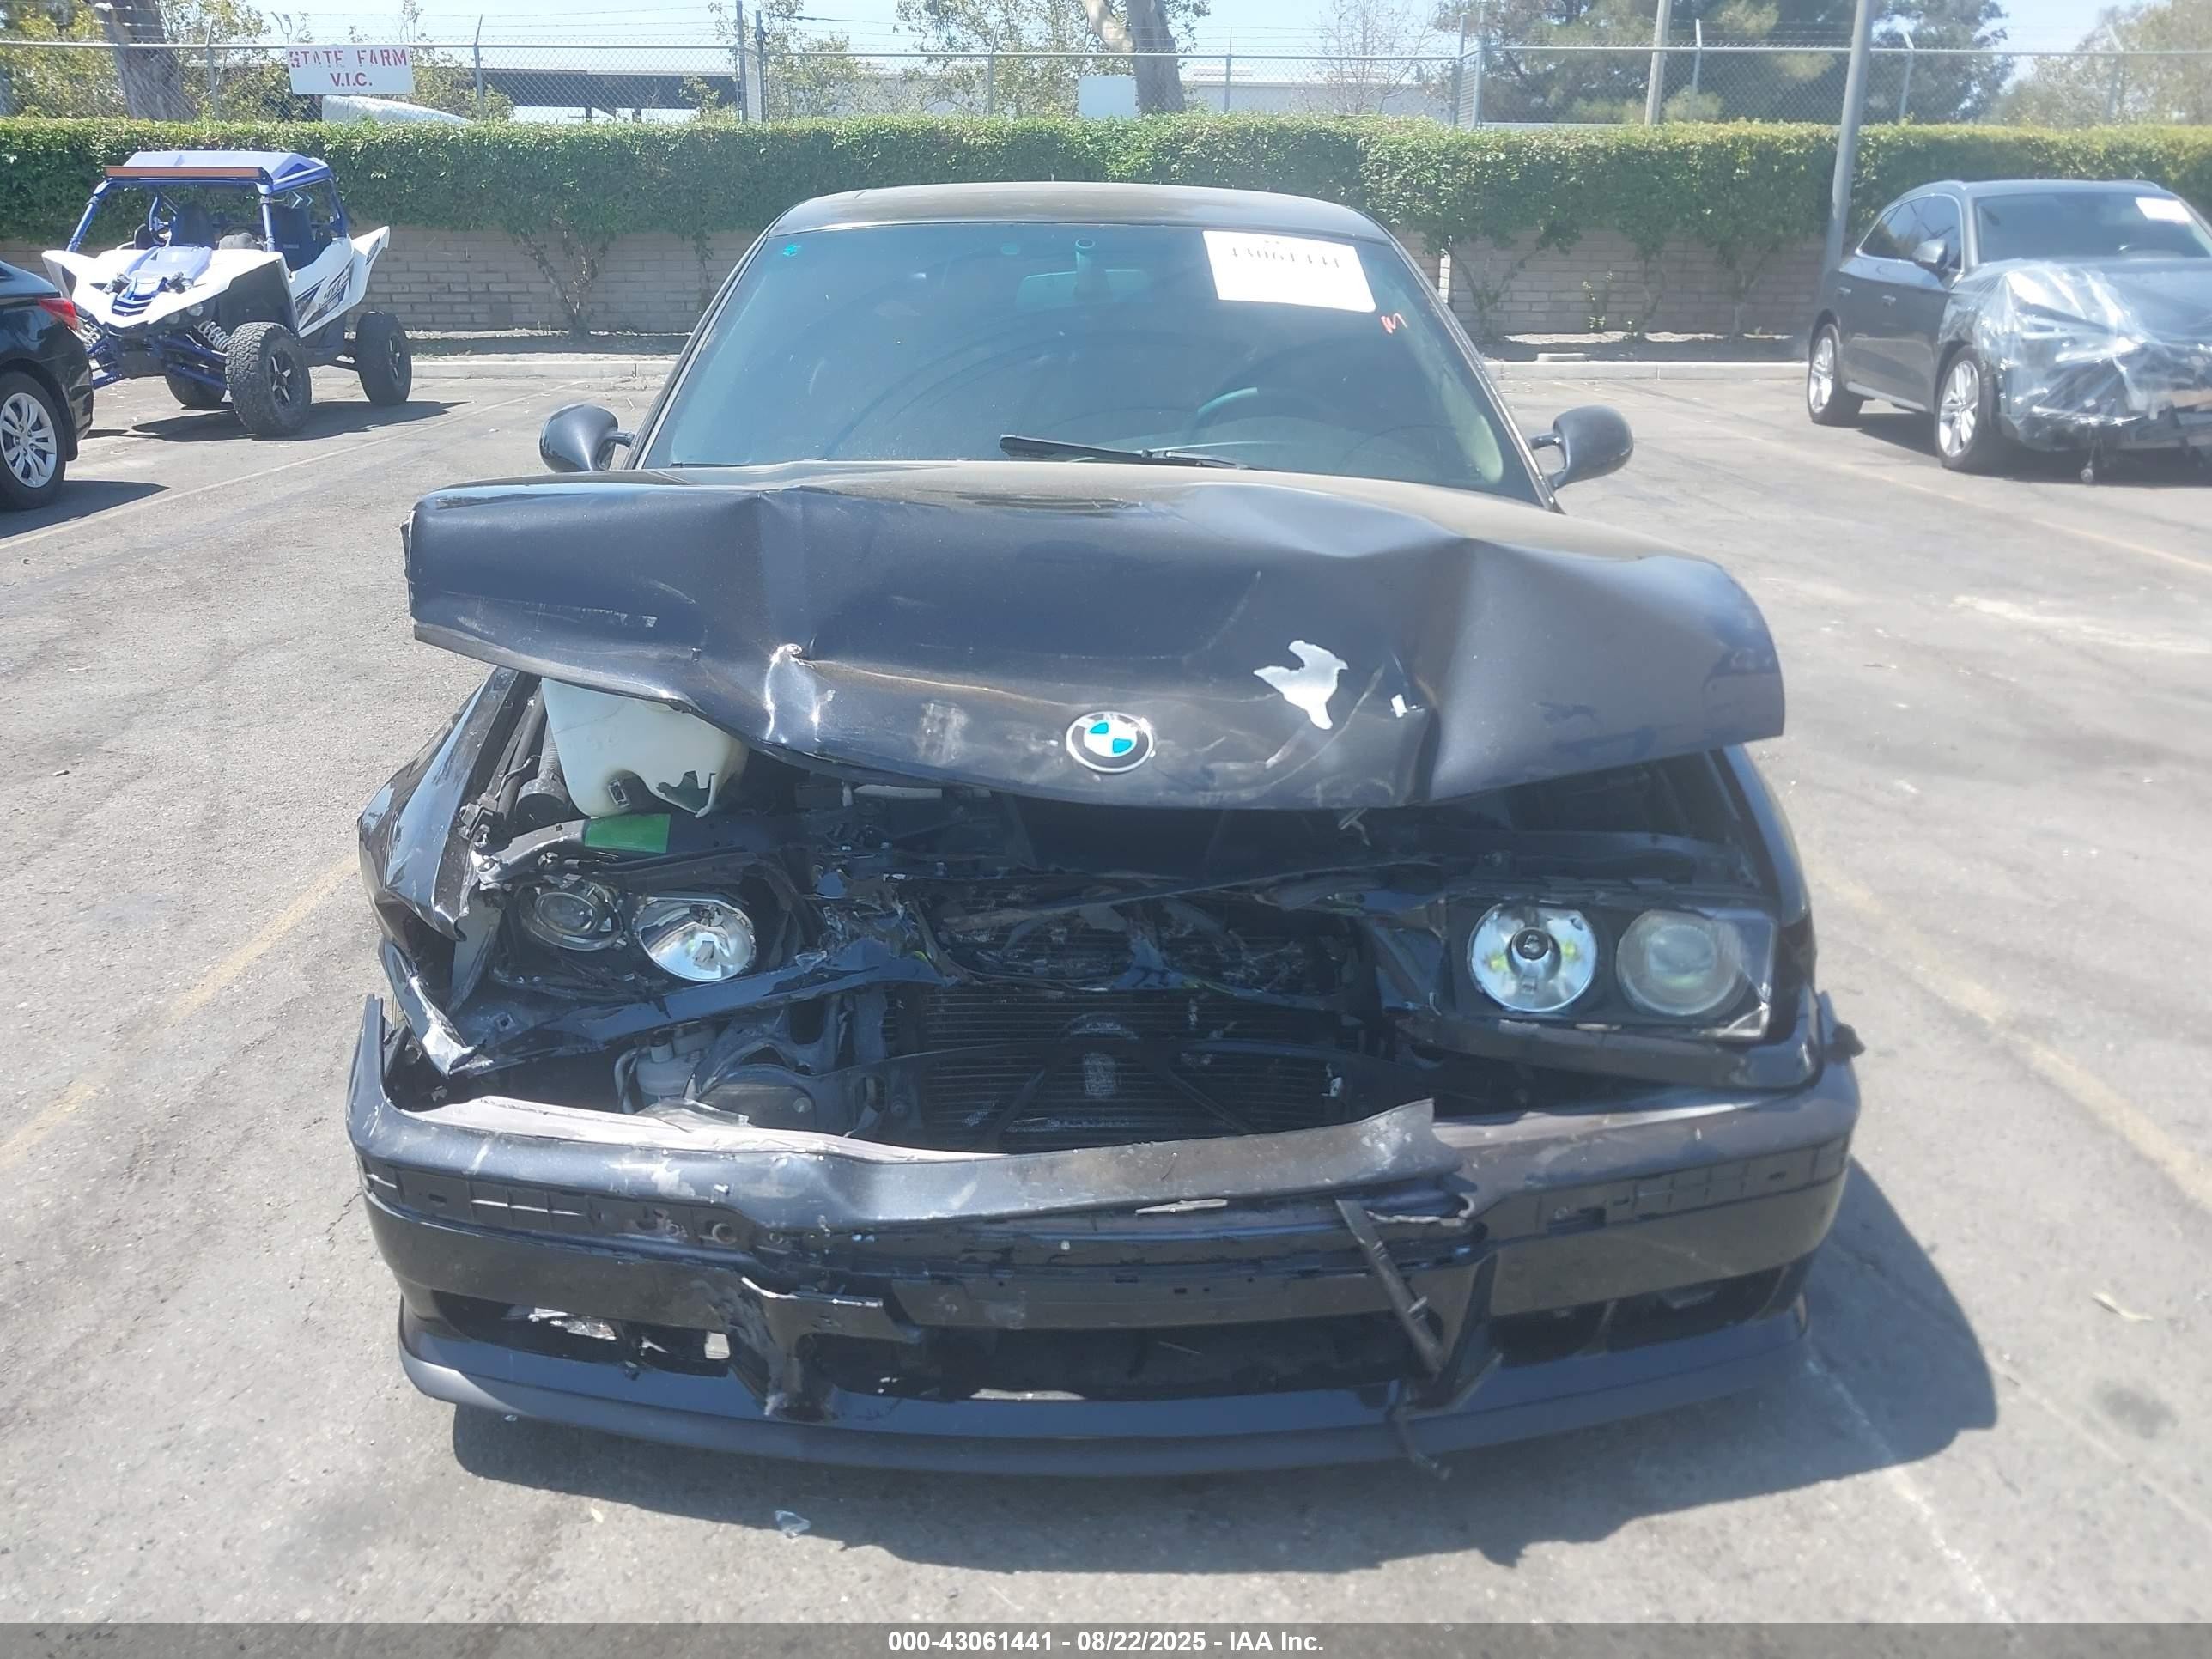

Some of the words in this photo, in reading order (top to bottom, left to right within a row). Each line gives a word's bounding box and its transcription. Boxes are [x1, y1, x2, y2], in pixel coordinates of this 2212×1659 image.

[289, 50, 346, 69] STATE
[356, 48, 408, 67] FARM
[329, 72, 373, 87] V.I.C.
